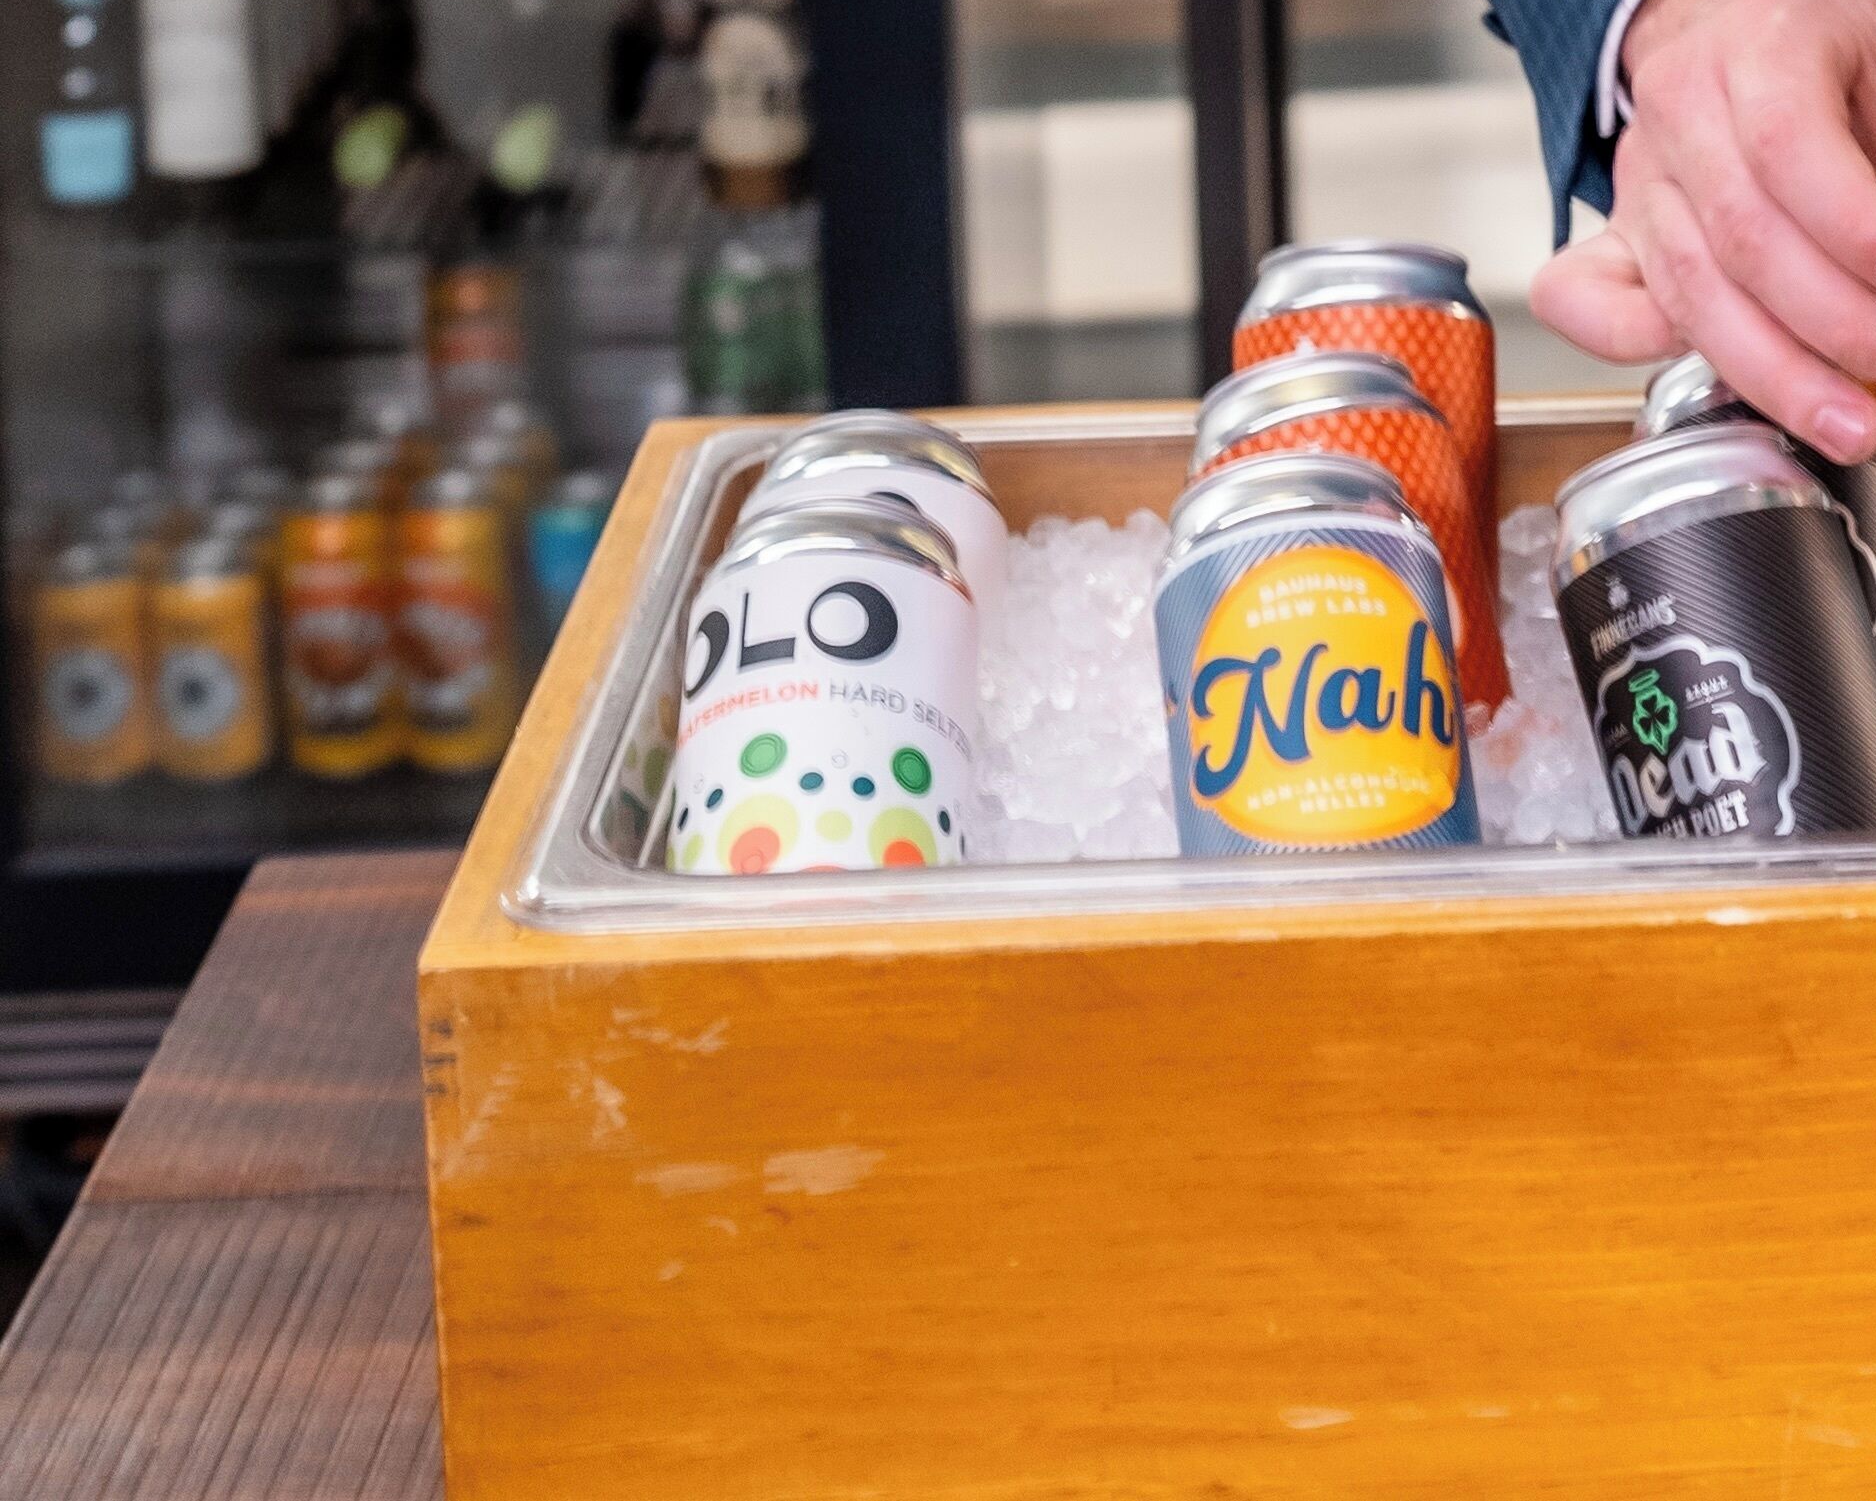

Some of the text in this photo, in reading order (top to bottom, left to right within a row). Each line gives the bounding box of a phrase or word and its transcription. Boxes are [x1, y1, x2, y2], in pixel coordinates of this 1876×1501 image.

[1326, 596, 1387, 616] LABS
[829, 679, 905, 714] HARD
[1192, 620, 1452, 797] Nah
[1611, 702, 1769, 837] Dead
[1690, 789, 1749, 837] POET
